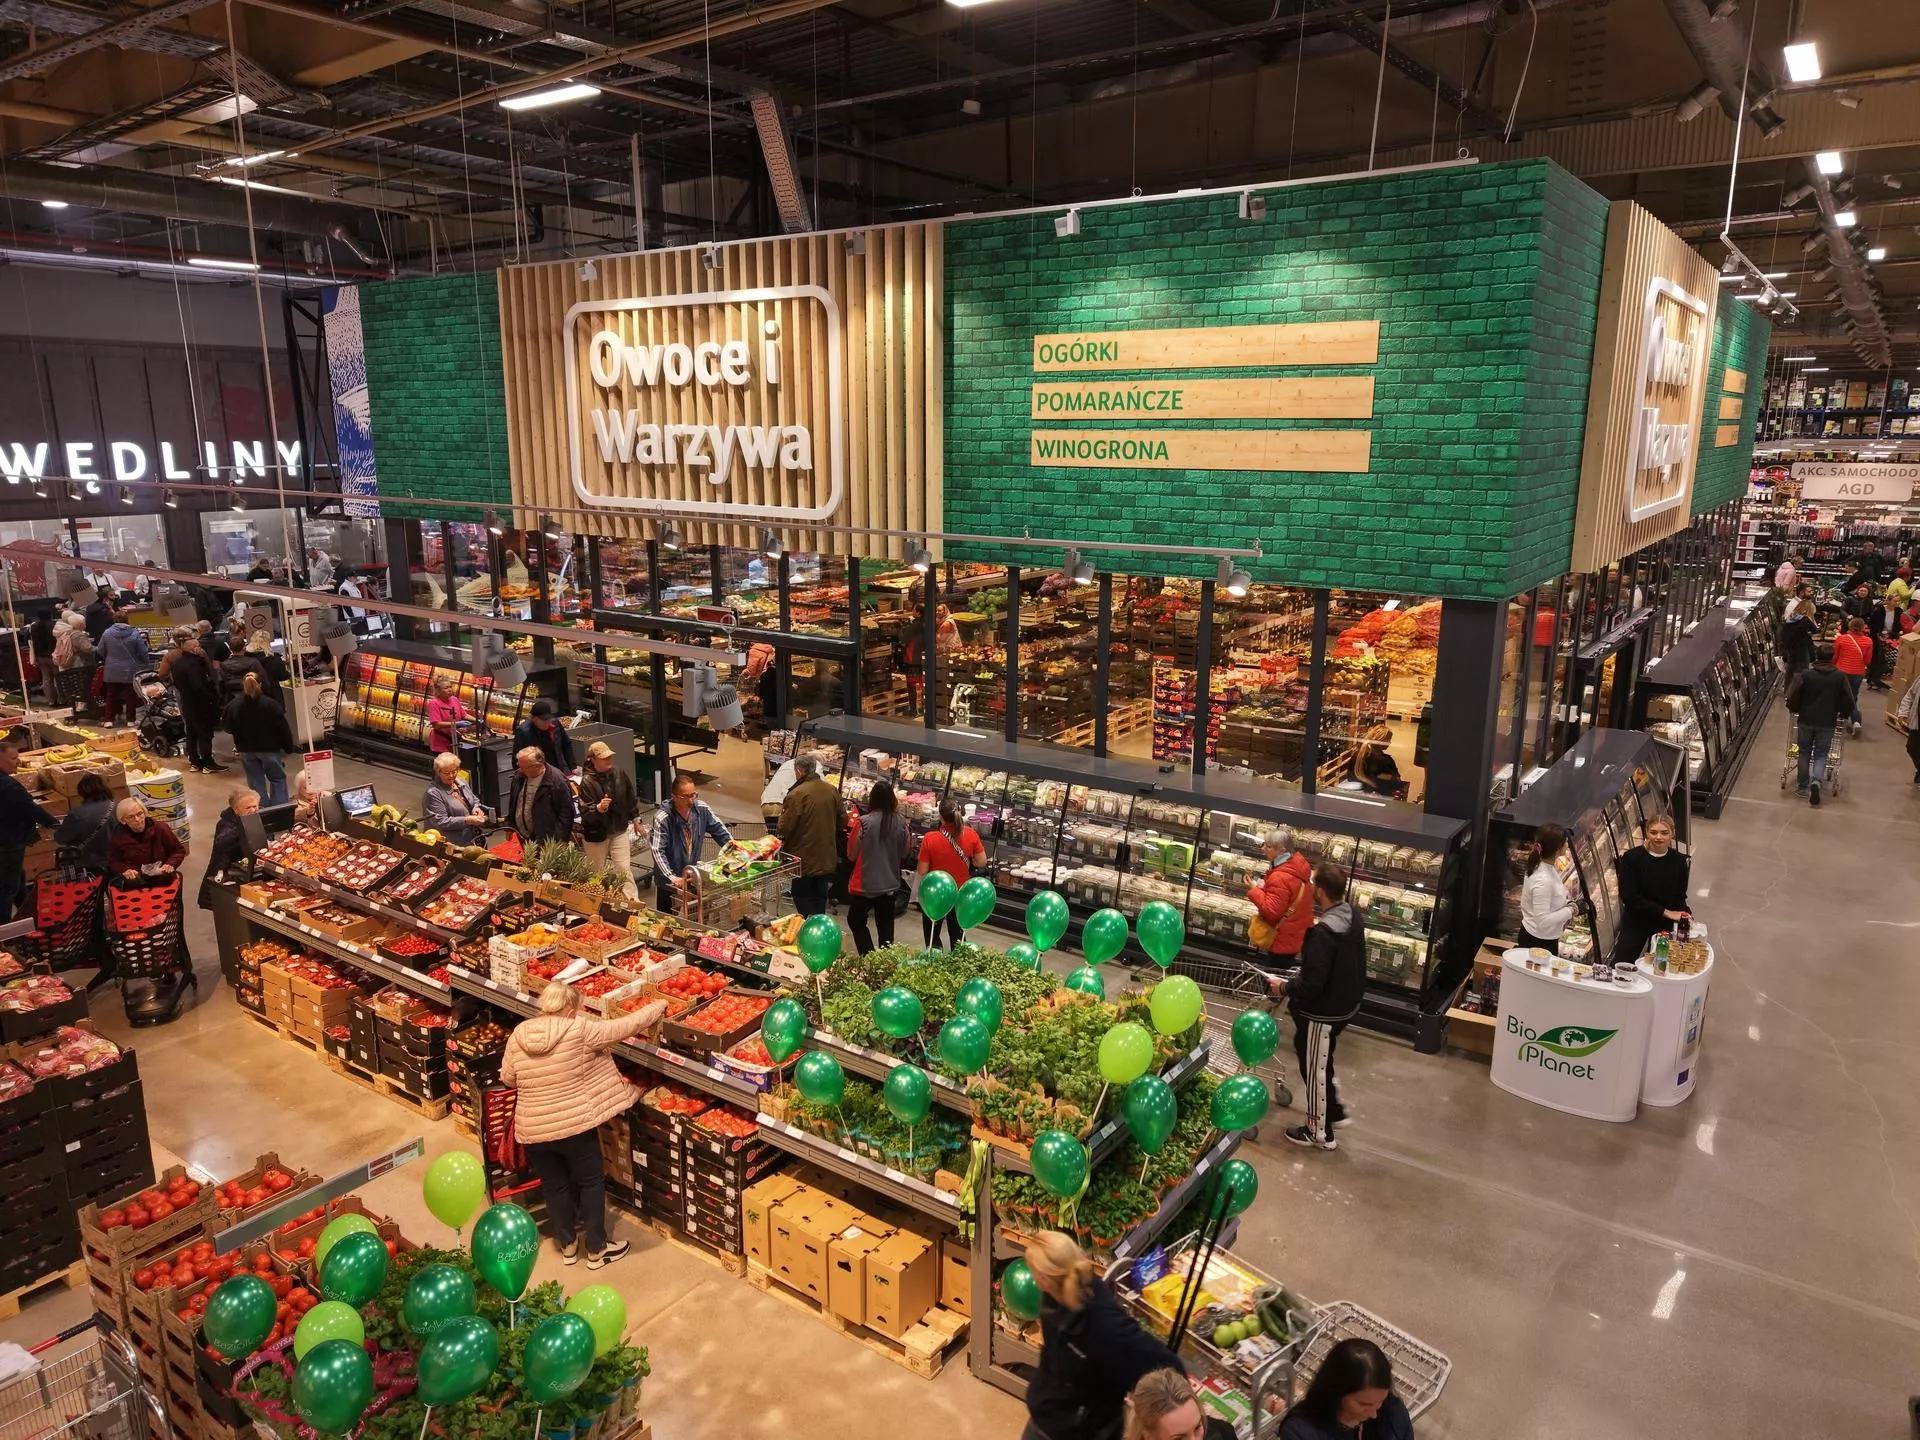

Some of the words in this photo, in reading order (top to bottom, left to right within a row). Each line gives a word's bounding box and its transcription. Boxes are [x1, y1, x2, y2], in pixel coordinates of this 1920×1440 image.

[590, 331, 750, 388] Owoce
[764, 320, 780, 385] i
[1039, 337, 1118, 363] OGÓRKI
[1037, 385, 1183, 412] POMARAŃCZE
[591, 408, 813, 485] Warzywa
[1036, 439, 1169, 461] WINOGRONA
[0, 441, 301, 494] WĘDLINY
[1798, 466, 1827, 477] AKC.
[1830, 467, 1919, 478] SAMOCHODO
[1838, 483, 1876, 495] AGD
[1507, 1015, 1537, 1041] Bio
[1526, 1046, 1595, 1080] Planet
